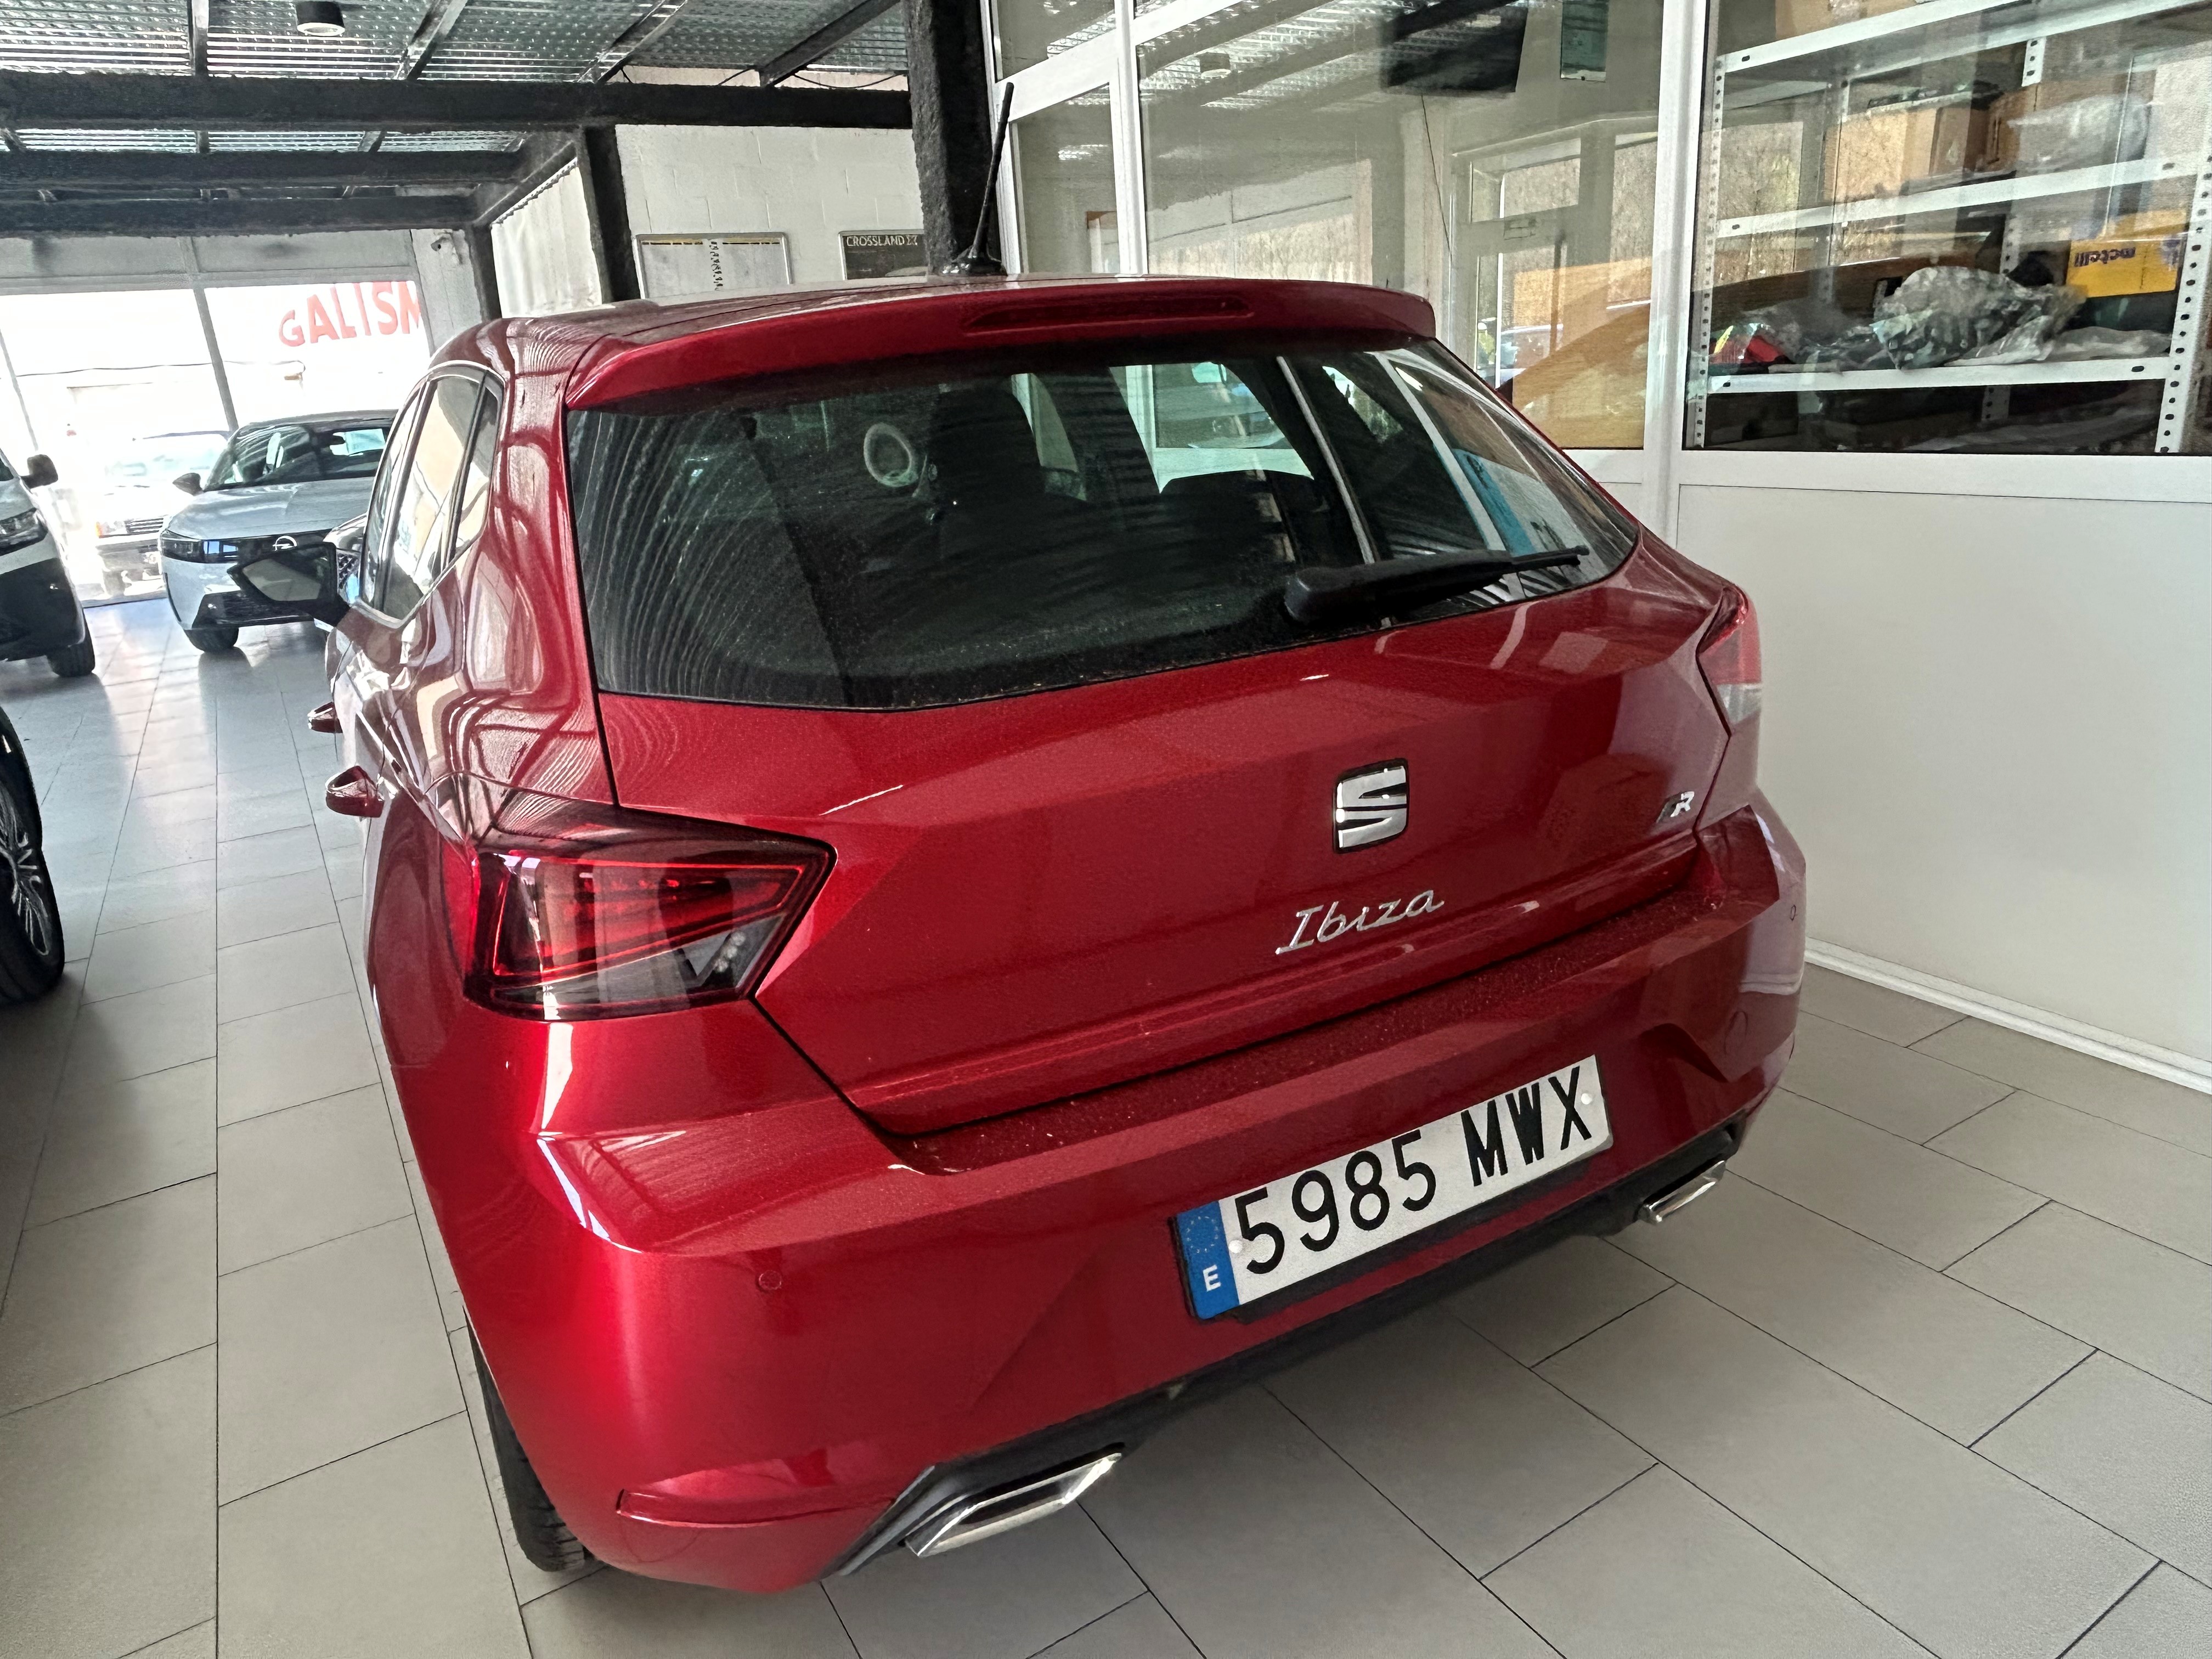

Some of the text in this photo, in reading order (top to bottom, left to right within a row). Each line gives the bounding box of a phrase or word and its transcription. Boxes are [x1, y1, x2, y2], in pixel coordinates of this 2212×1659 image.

[847, 235, 905, 246] CROSSLAND
[1275, 889, 1445, 955] Ibiza
[1234, 1065, 1592, 1274] 5985 MWX
[1203, 1264, 1221, 1291] E
